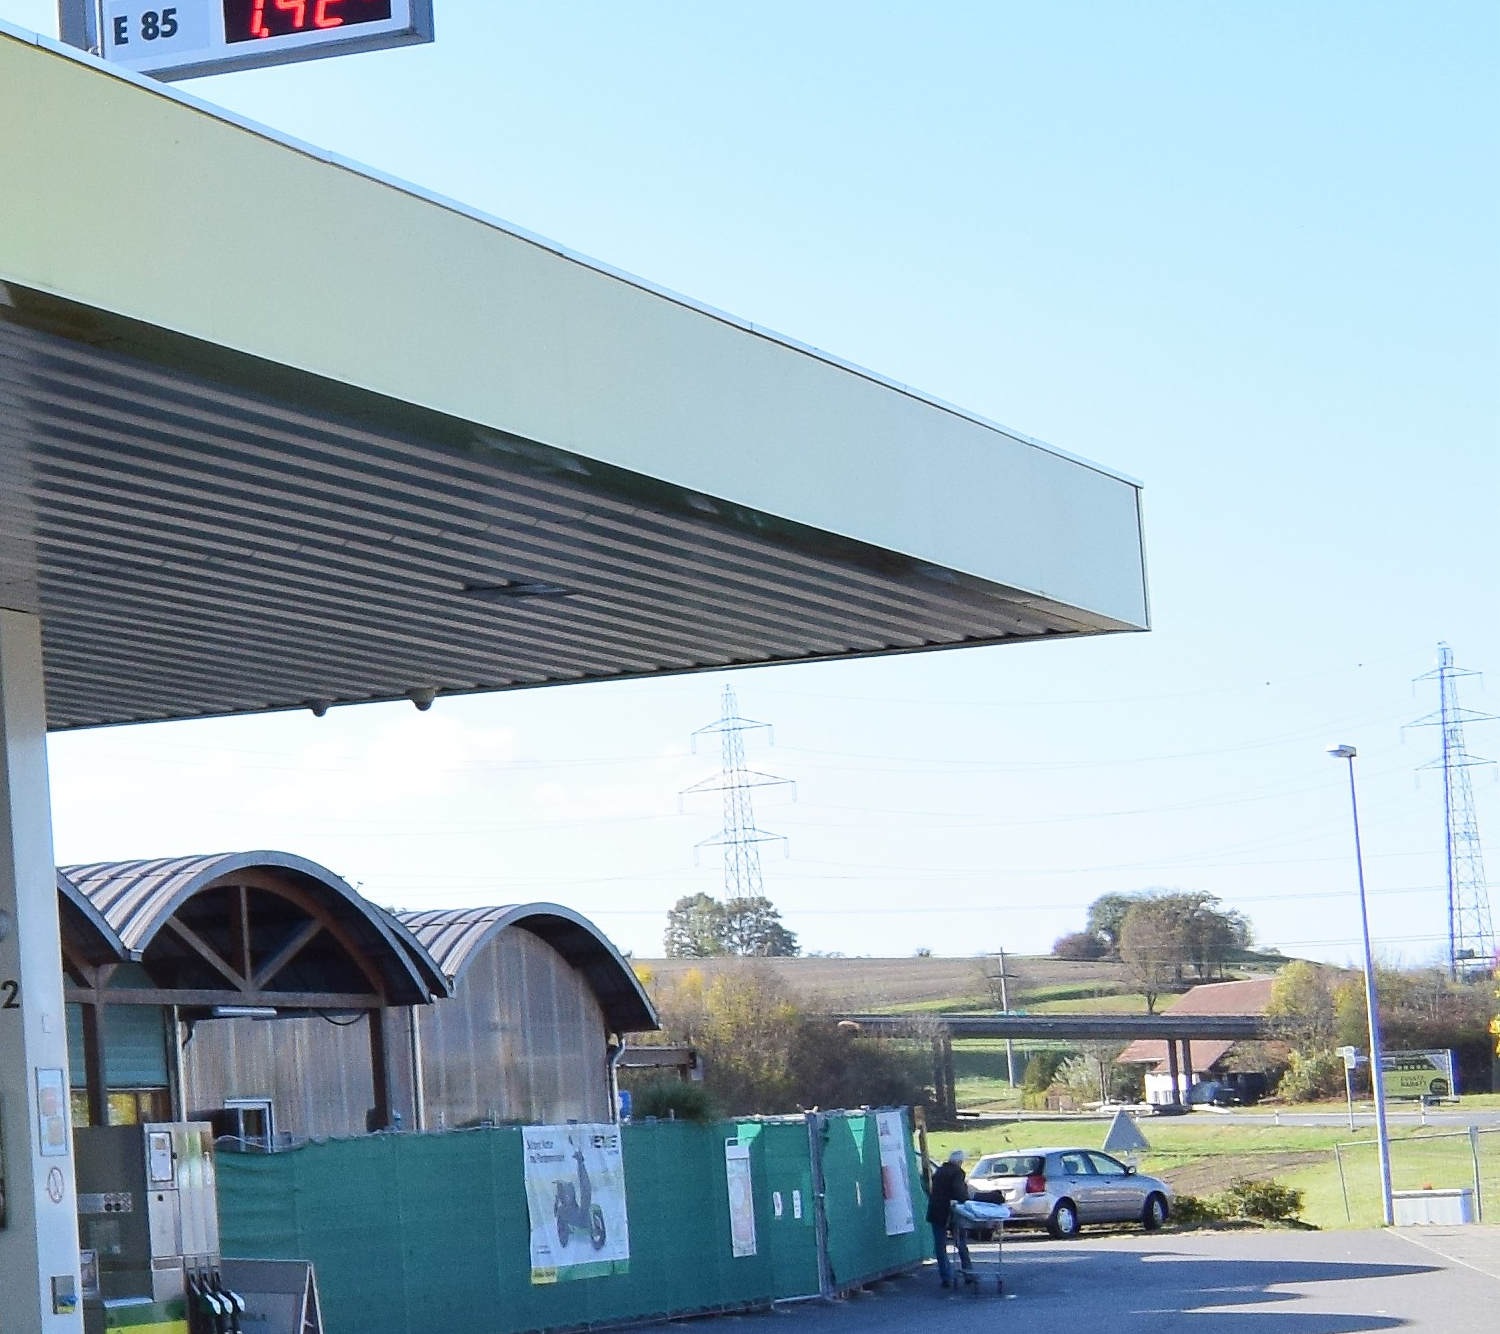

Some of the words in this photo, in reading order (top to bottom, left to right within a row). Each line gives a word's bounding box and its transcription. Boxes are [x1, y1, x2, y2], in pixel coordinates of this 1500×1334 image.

[114, 16, 129, 46] E
[141, 8, 179, 41] 85
[0, 979, 21, 1009] 2
